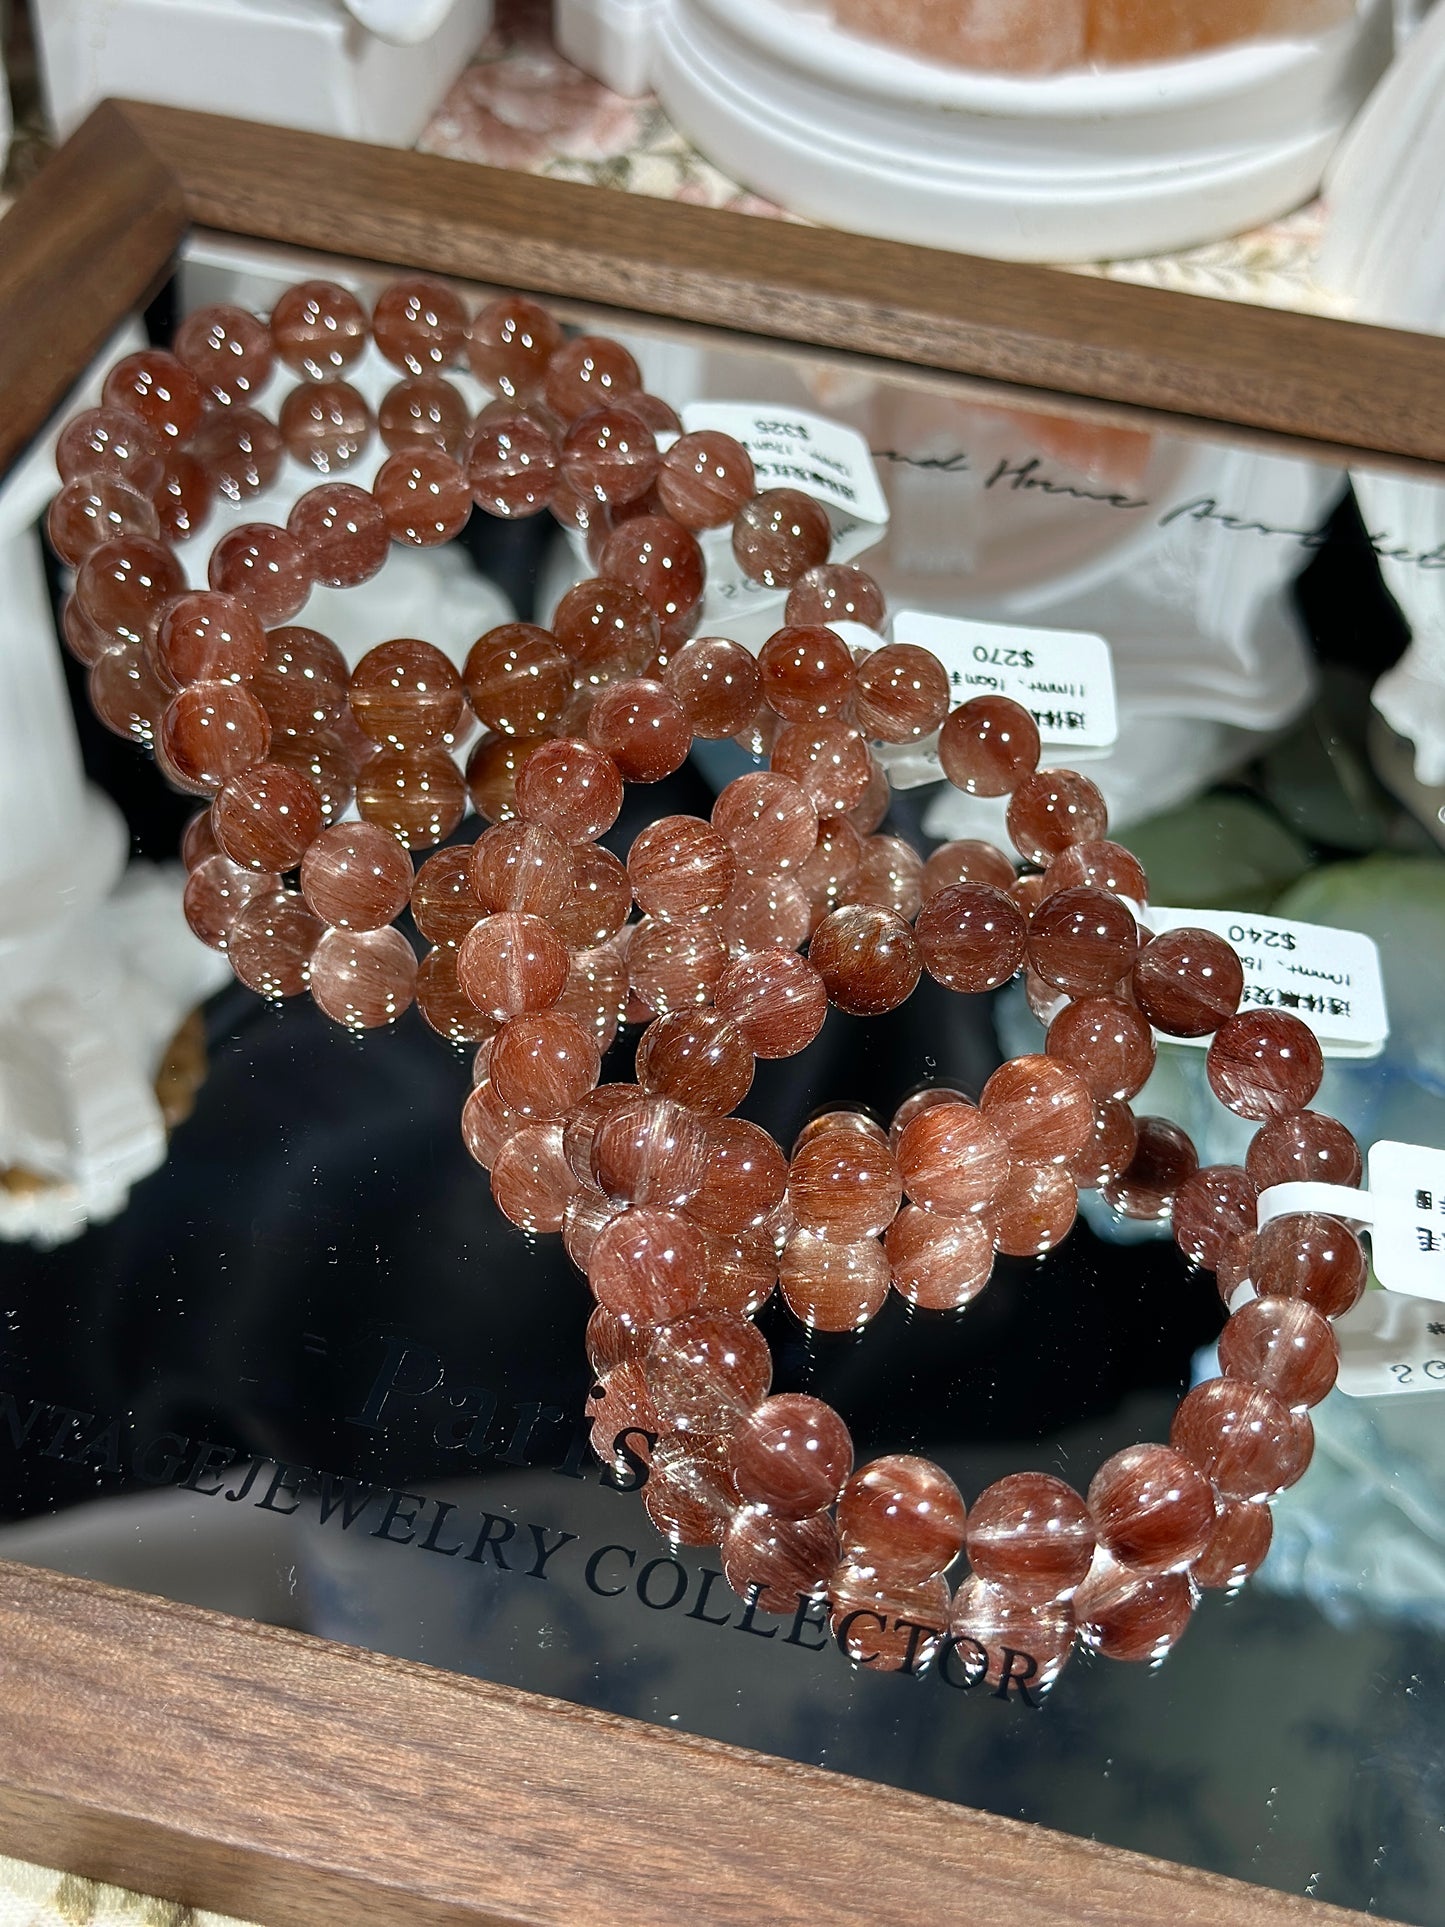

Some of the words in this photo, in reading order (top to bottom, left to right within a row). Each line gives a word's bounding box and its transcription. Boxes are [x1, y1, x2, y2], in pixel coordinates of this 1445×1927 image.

[972, 645, 1035, 669] $270
[1228, 925, 1297, 951] $240
[344, 1334, 658, 1492] Paris
[584, 1543, 1042, 1709] COLLECTOR
